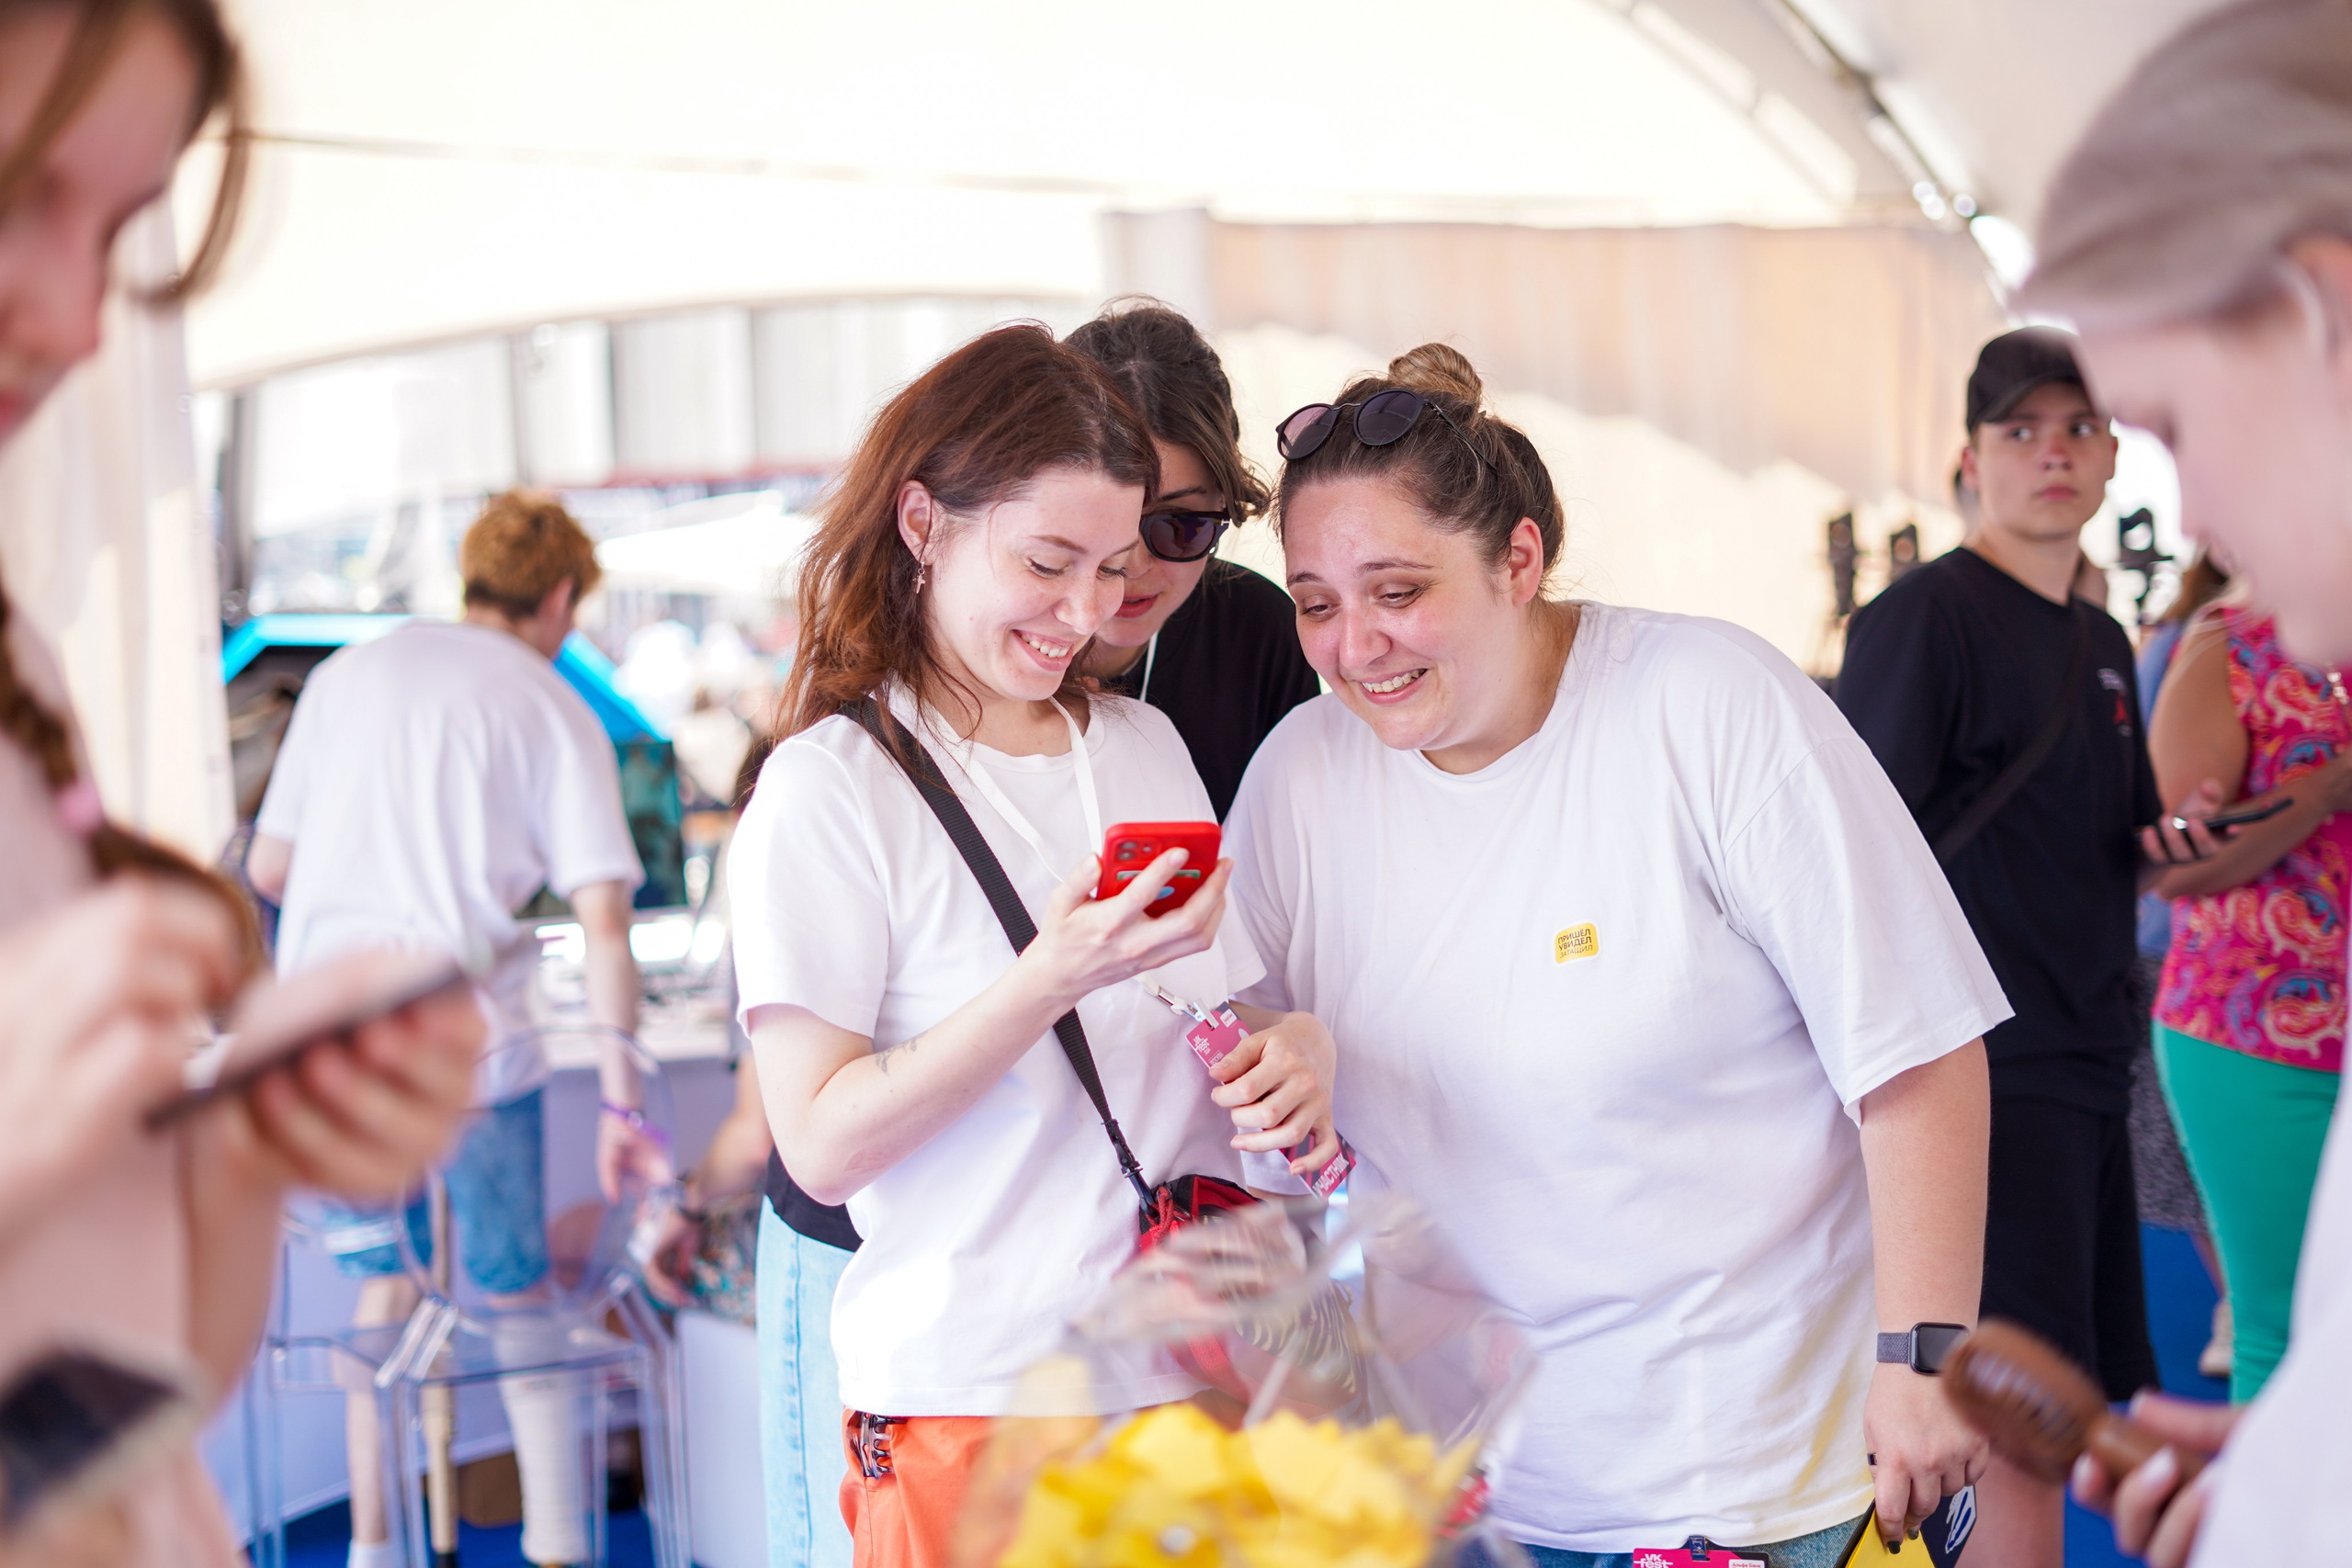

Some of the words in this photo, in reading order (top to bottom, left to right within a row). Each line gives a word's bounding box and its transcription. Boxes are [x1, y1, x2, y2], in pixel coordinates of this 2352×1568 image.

[1558, 928, 1591, 944] ПРИШЁЛ
[1558, 936, 1592, 951] УВИДЕЛ
[1560, 944, 1593, 958] ЗАТАЩИЛ
[1311, 1152, 1350, 1197] УЧАСТНИК
[1634, 1558, 1673, 1568] fest
[1645, 1553, 1662, 1562] VK
